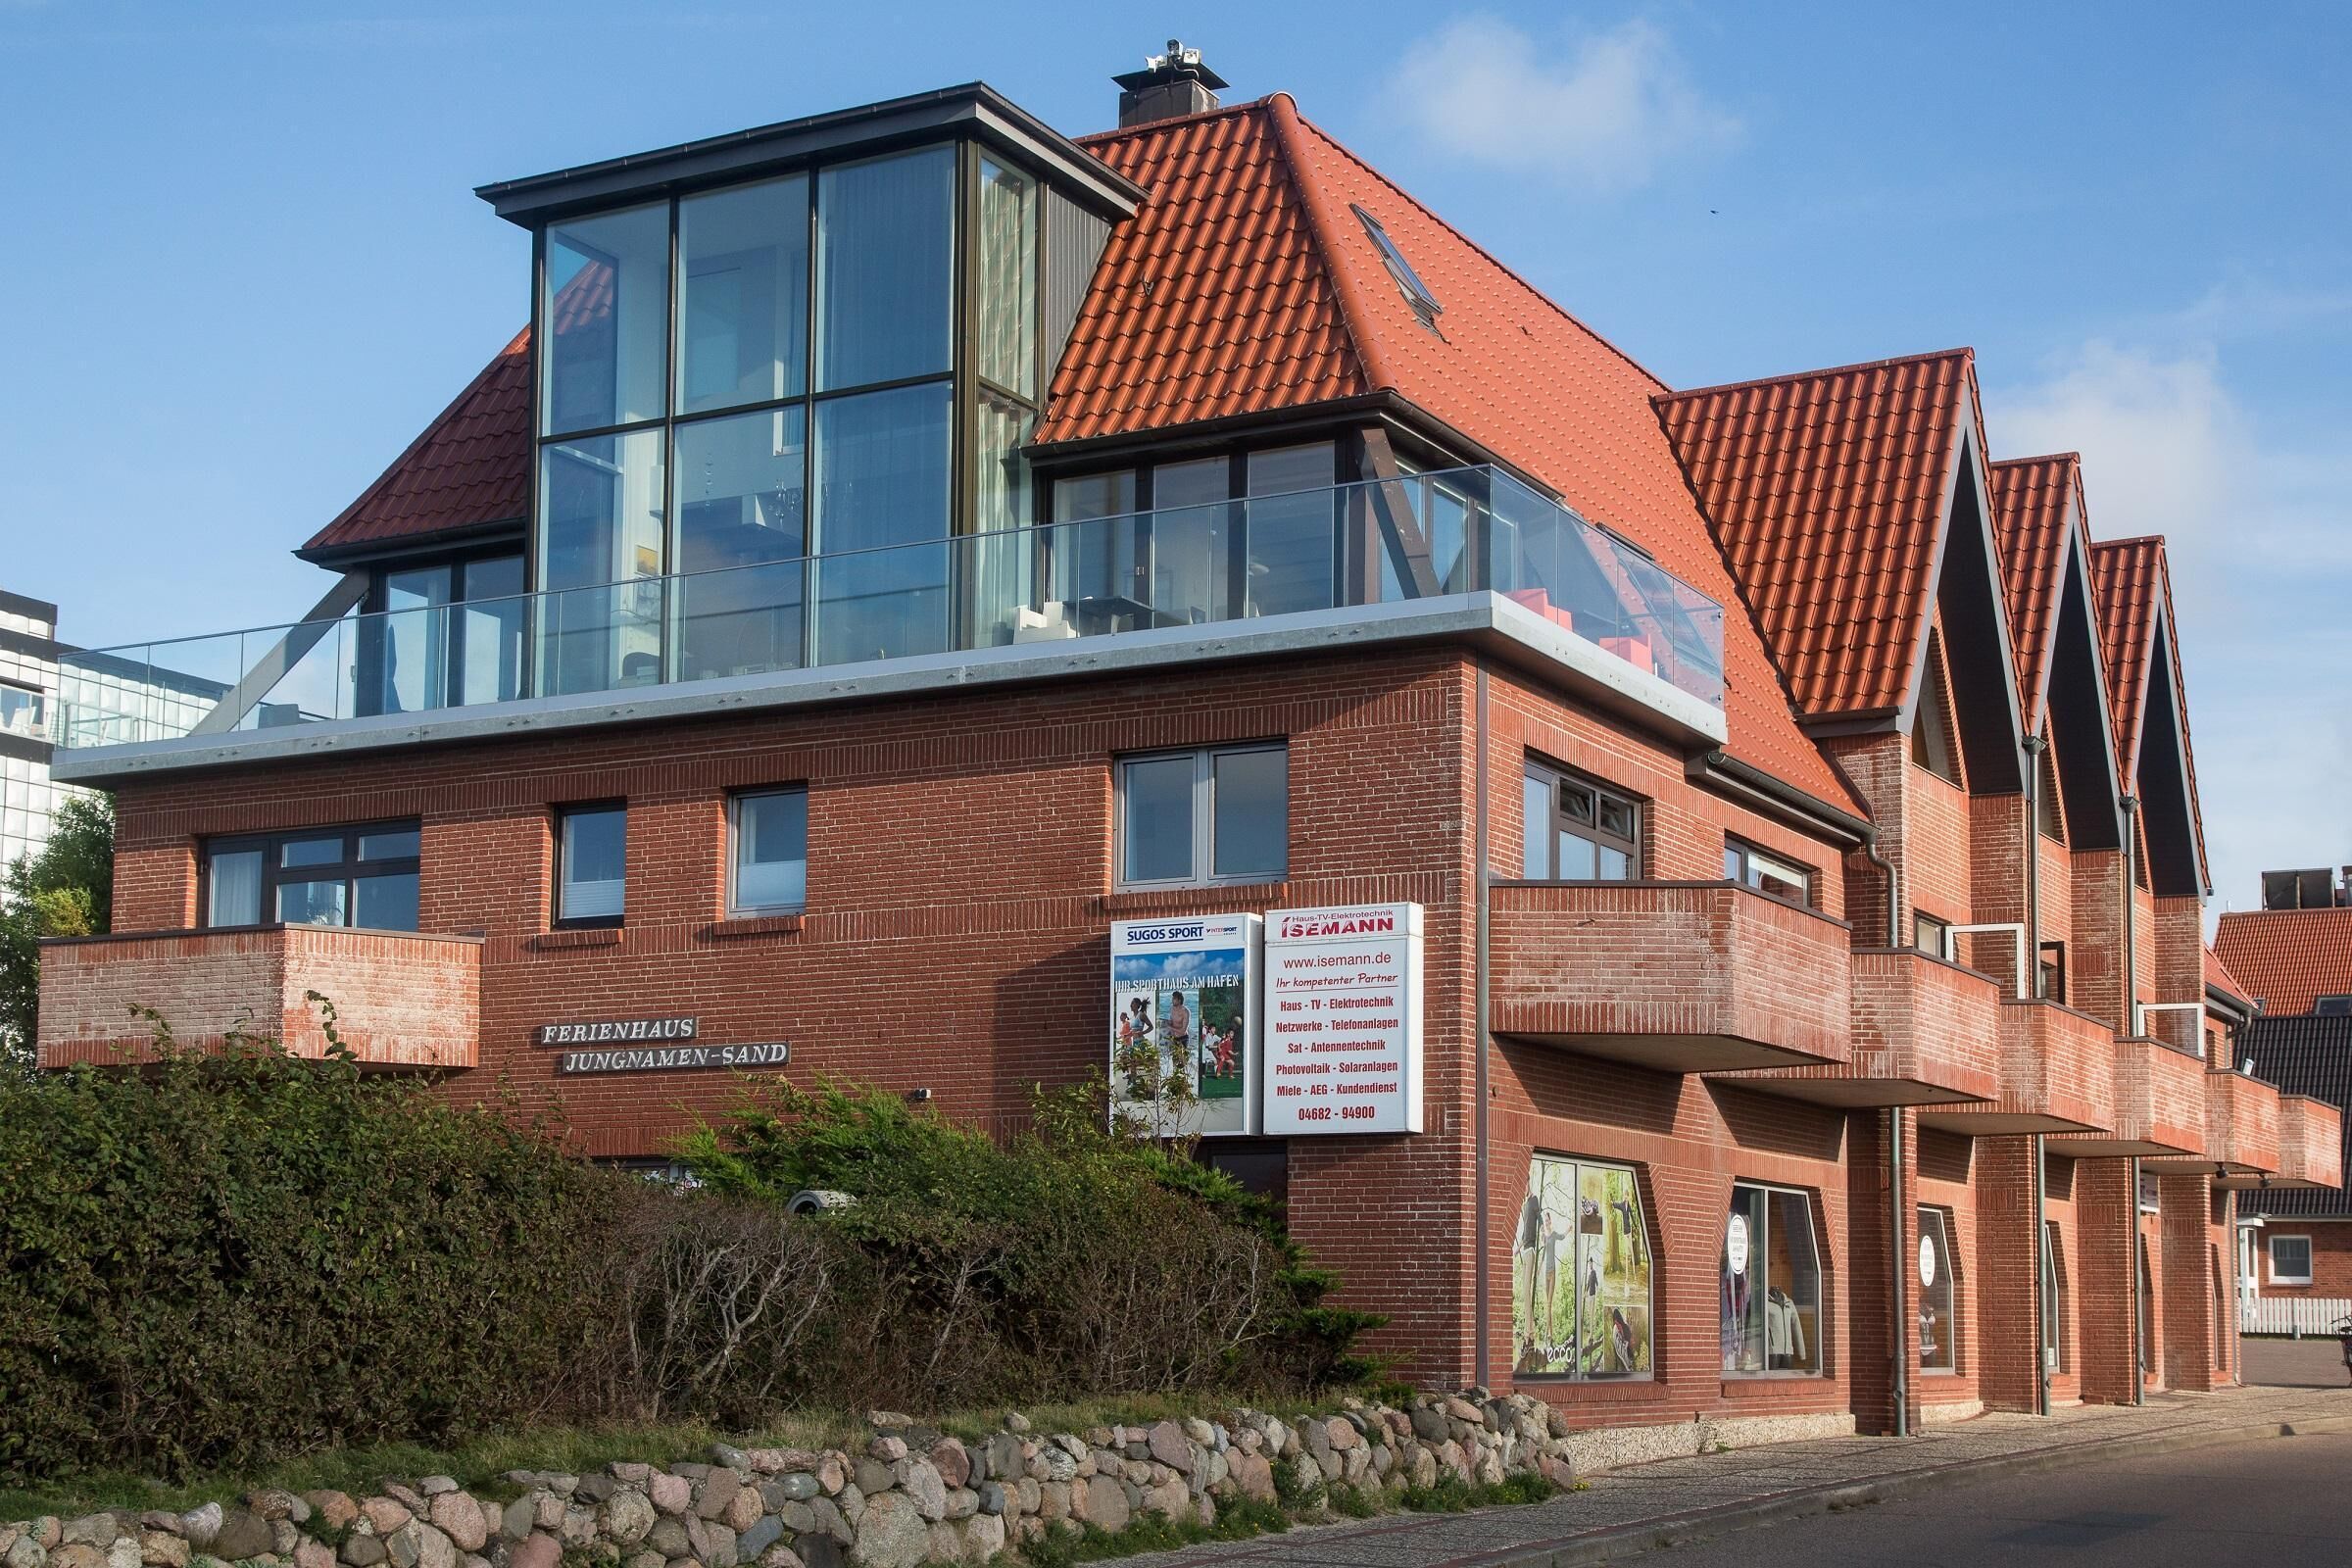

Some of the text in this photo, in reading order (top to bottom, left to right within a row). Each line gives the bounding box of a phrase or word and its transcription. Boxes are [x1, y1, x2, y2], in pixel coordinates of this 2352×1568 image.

[1293, 909, 1394, 922] Haus-TV-Elektrotechnik
[1128, 926, 1204, 942] SUGOS SPORT
[1284, 952, 1392, 968] www.isemann.de
[1115, 974, 1240, 993] IHR SPORTHAUS AM HAFEN
[1276, 972, 1398, 989] Ihr kompetenter Partner
[1280, 1001, 1301, 1011] Haus
[1310, 1000, 1321, 1010] TV
[1330, 996, 1394, 1009] Elektrotechnik
[543, 1018, 694, 1043] FERIENHAUS
[1276, 1021, 1322, 1033] Netzwerke
[1331, 1018, 1398, 1031] Telefonanlagen
[1288, 1043, 1302, 1054] Sat
[1310, 1040, 1386, 1053] Antennentechnik
[1276, 1063, 1331, 1075] Photovoltaik
[1339, 1061, 1398, 1073] Solaranlagen
[1277, 1086, 1301, 1097] Miele
[1310, 1084, 1328, 1096] AEG
[1337, 1082, 1397, 1095] Kundendienst
[1298, 1107, 1331, 1120] 04682
[1342, 1105, 1375, 1119] 94900
[1547, 1347, 1572, 1363] ecco
